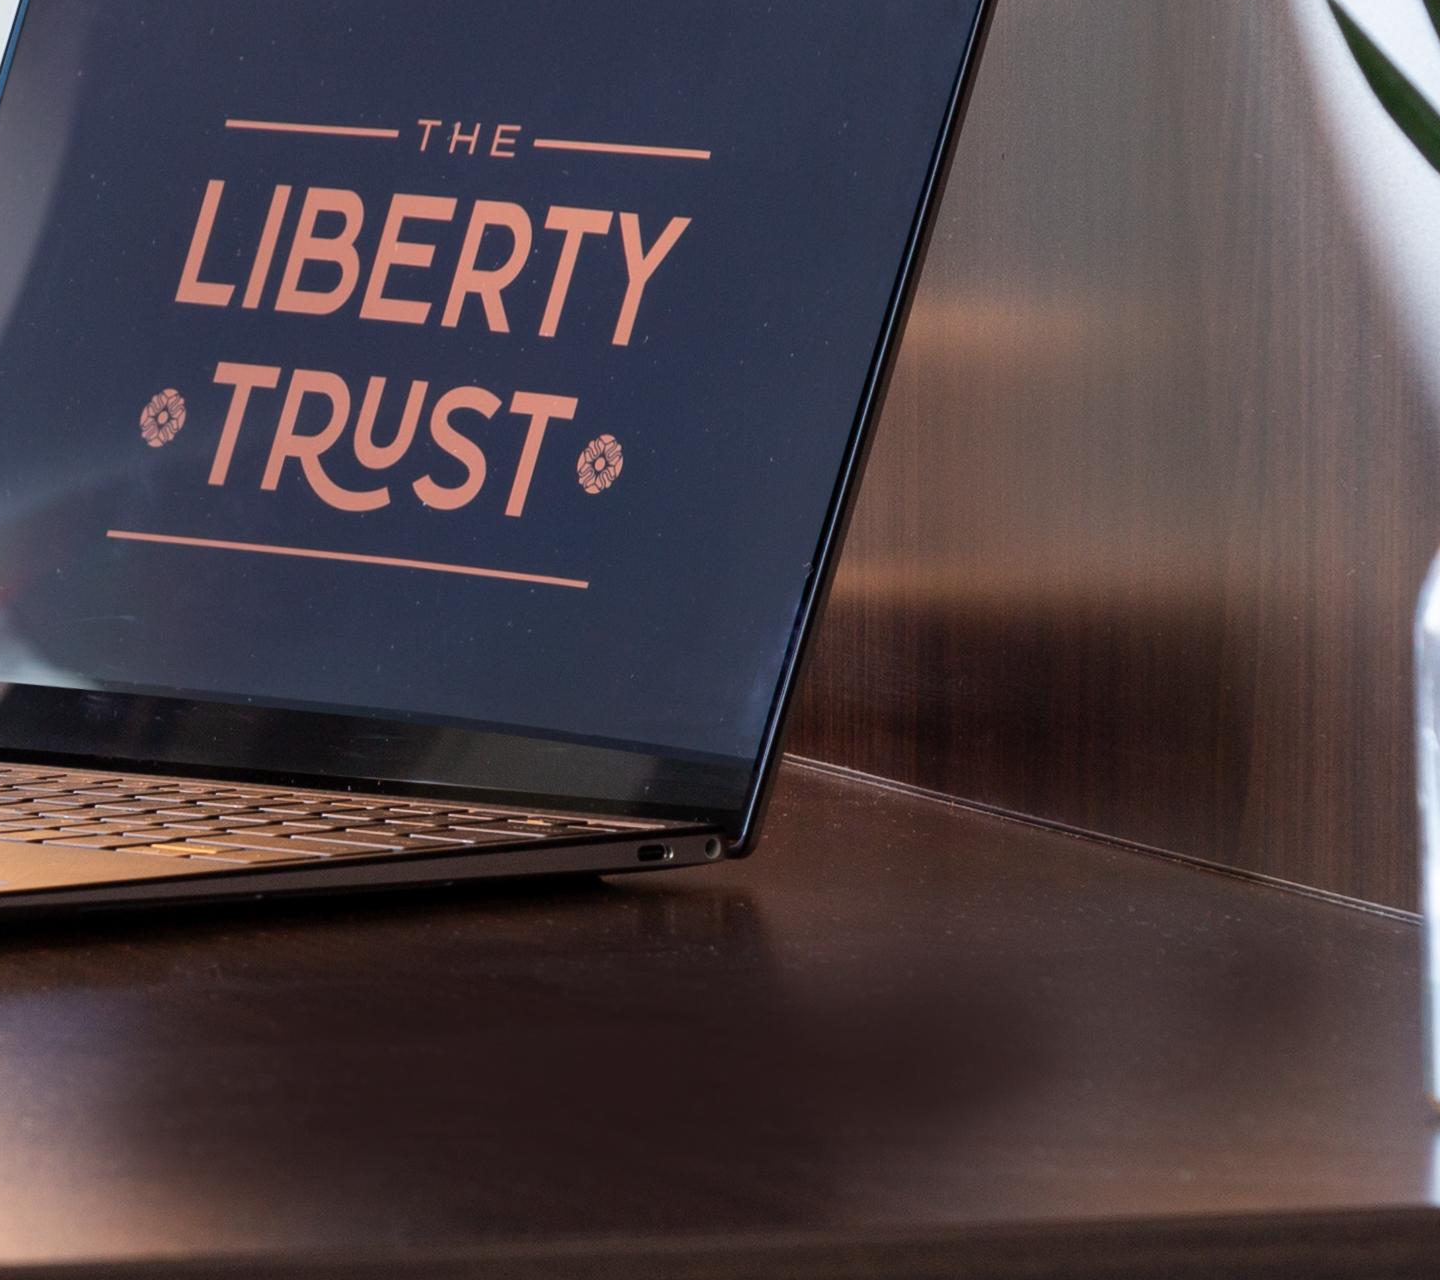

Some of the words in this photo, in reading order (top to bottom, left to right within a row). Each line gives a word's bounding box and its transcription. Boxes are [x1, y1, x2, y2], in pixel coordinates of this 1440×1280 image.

[417, 119, 522, 159] THE
[174, 179, 692, 347] LIBERTY
[207, 361, 579, 518] TRUST
